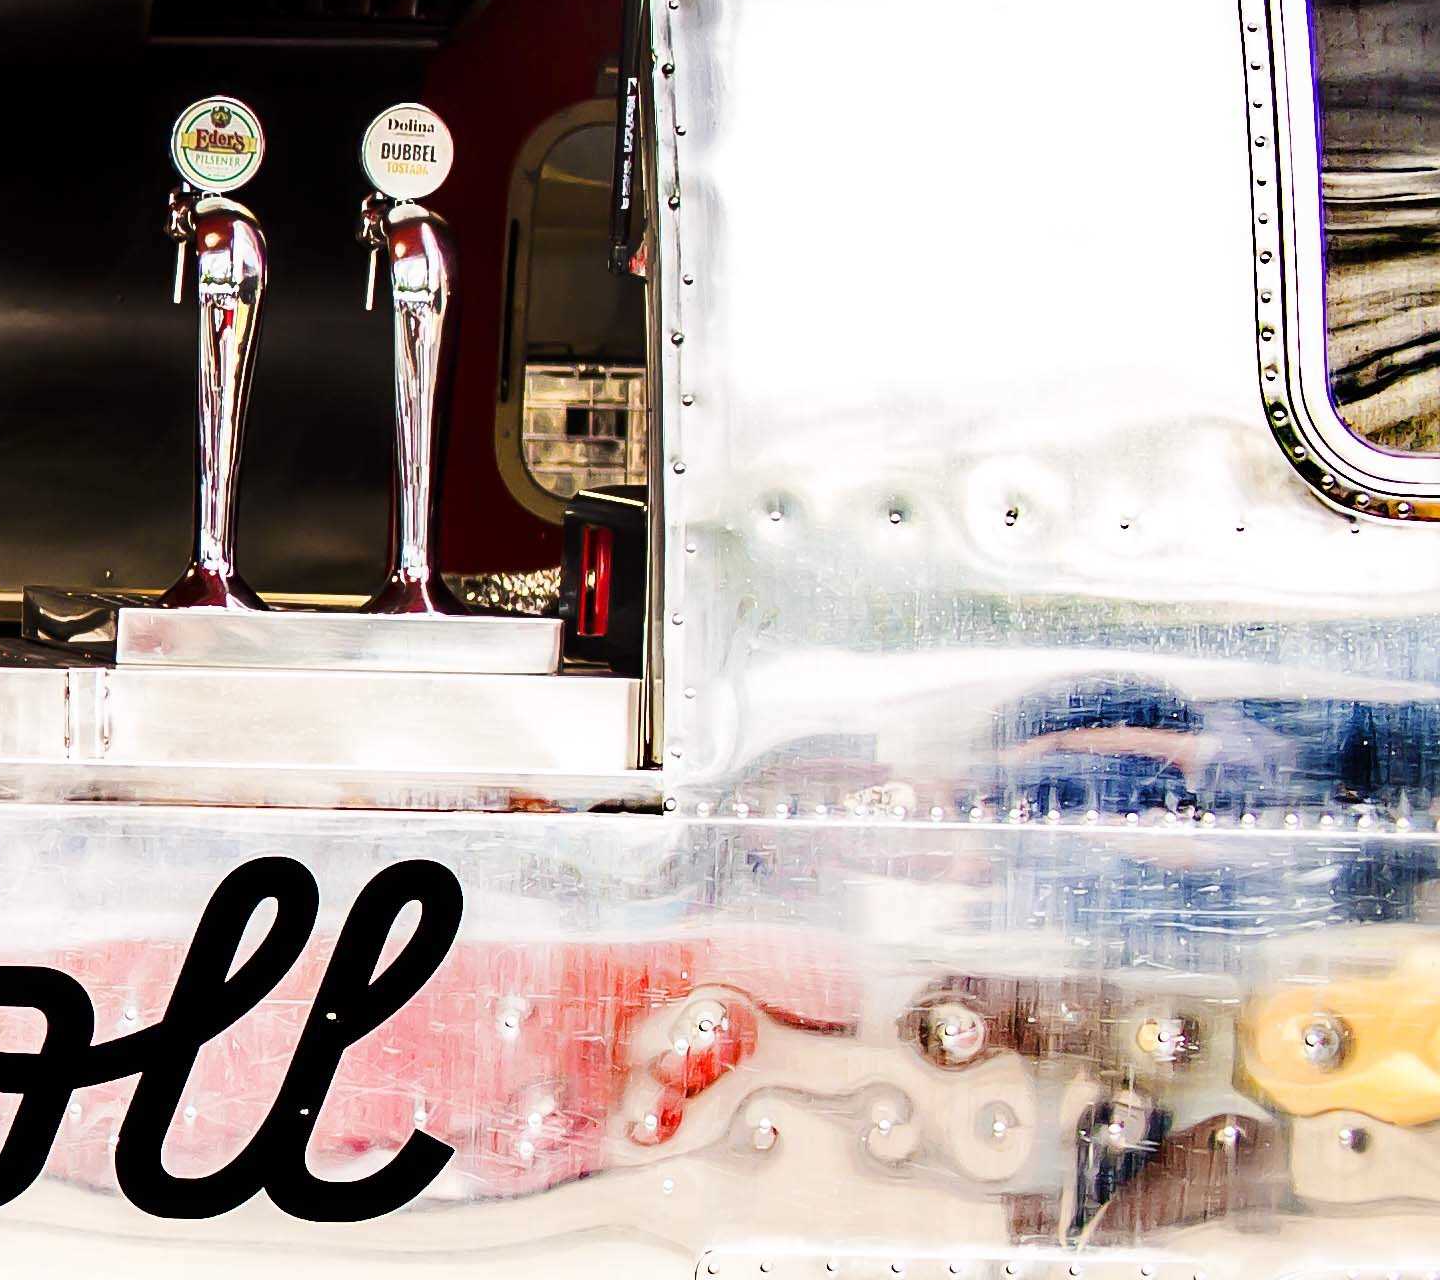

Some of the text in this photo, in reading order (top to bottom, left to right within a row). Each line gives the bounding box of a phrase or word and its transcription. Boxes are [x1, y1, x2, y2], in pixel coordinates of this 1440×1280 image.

[388, 118, 435, 133] Dolina
[196, 128, 245, 153] Eder's
[195, 153, 241, 166] PILSENER
[381, 143, 437, 162] DUBBEL
